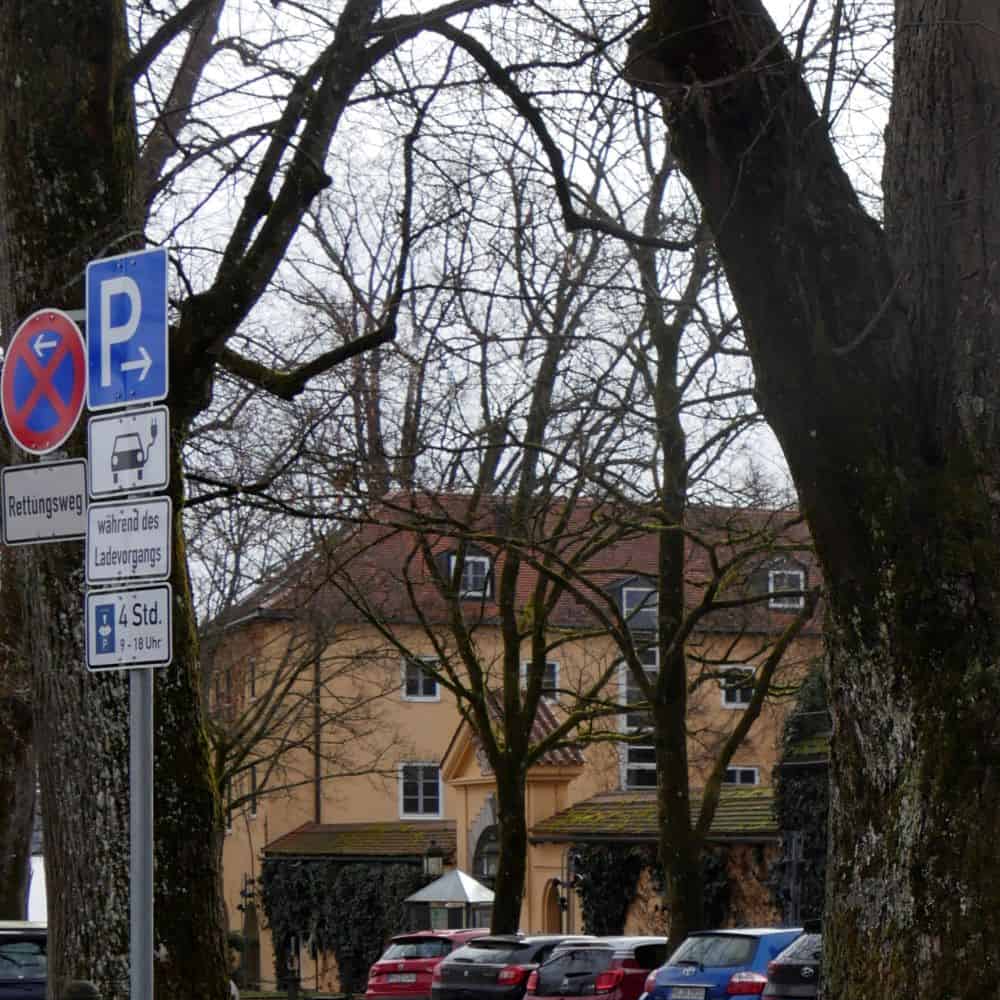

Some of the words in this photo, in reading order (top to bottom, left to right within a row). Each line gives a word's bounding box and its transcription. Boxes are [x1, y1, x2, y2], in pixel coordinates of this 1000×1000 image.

[101, 276, 142, 387] P
[8, 494, 83, 519] Rettungsweg
[97, 509, 139, 534] während
[142, 509, 160, 531] des
[95, 545, 161, 570] Ladevorgangs
[118, 604, 128, 628] 4
[132, 600, 162, 627] Std.
[119, 638, 126, 652] 9
[133, 636, 144, 651] 18
[145, 635, 162, 650] Uhr
